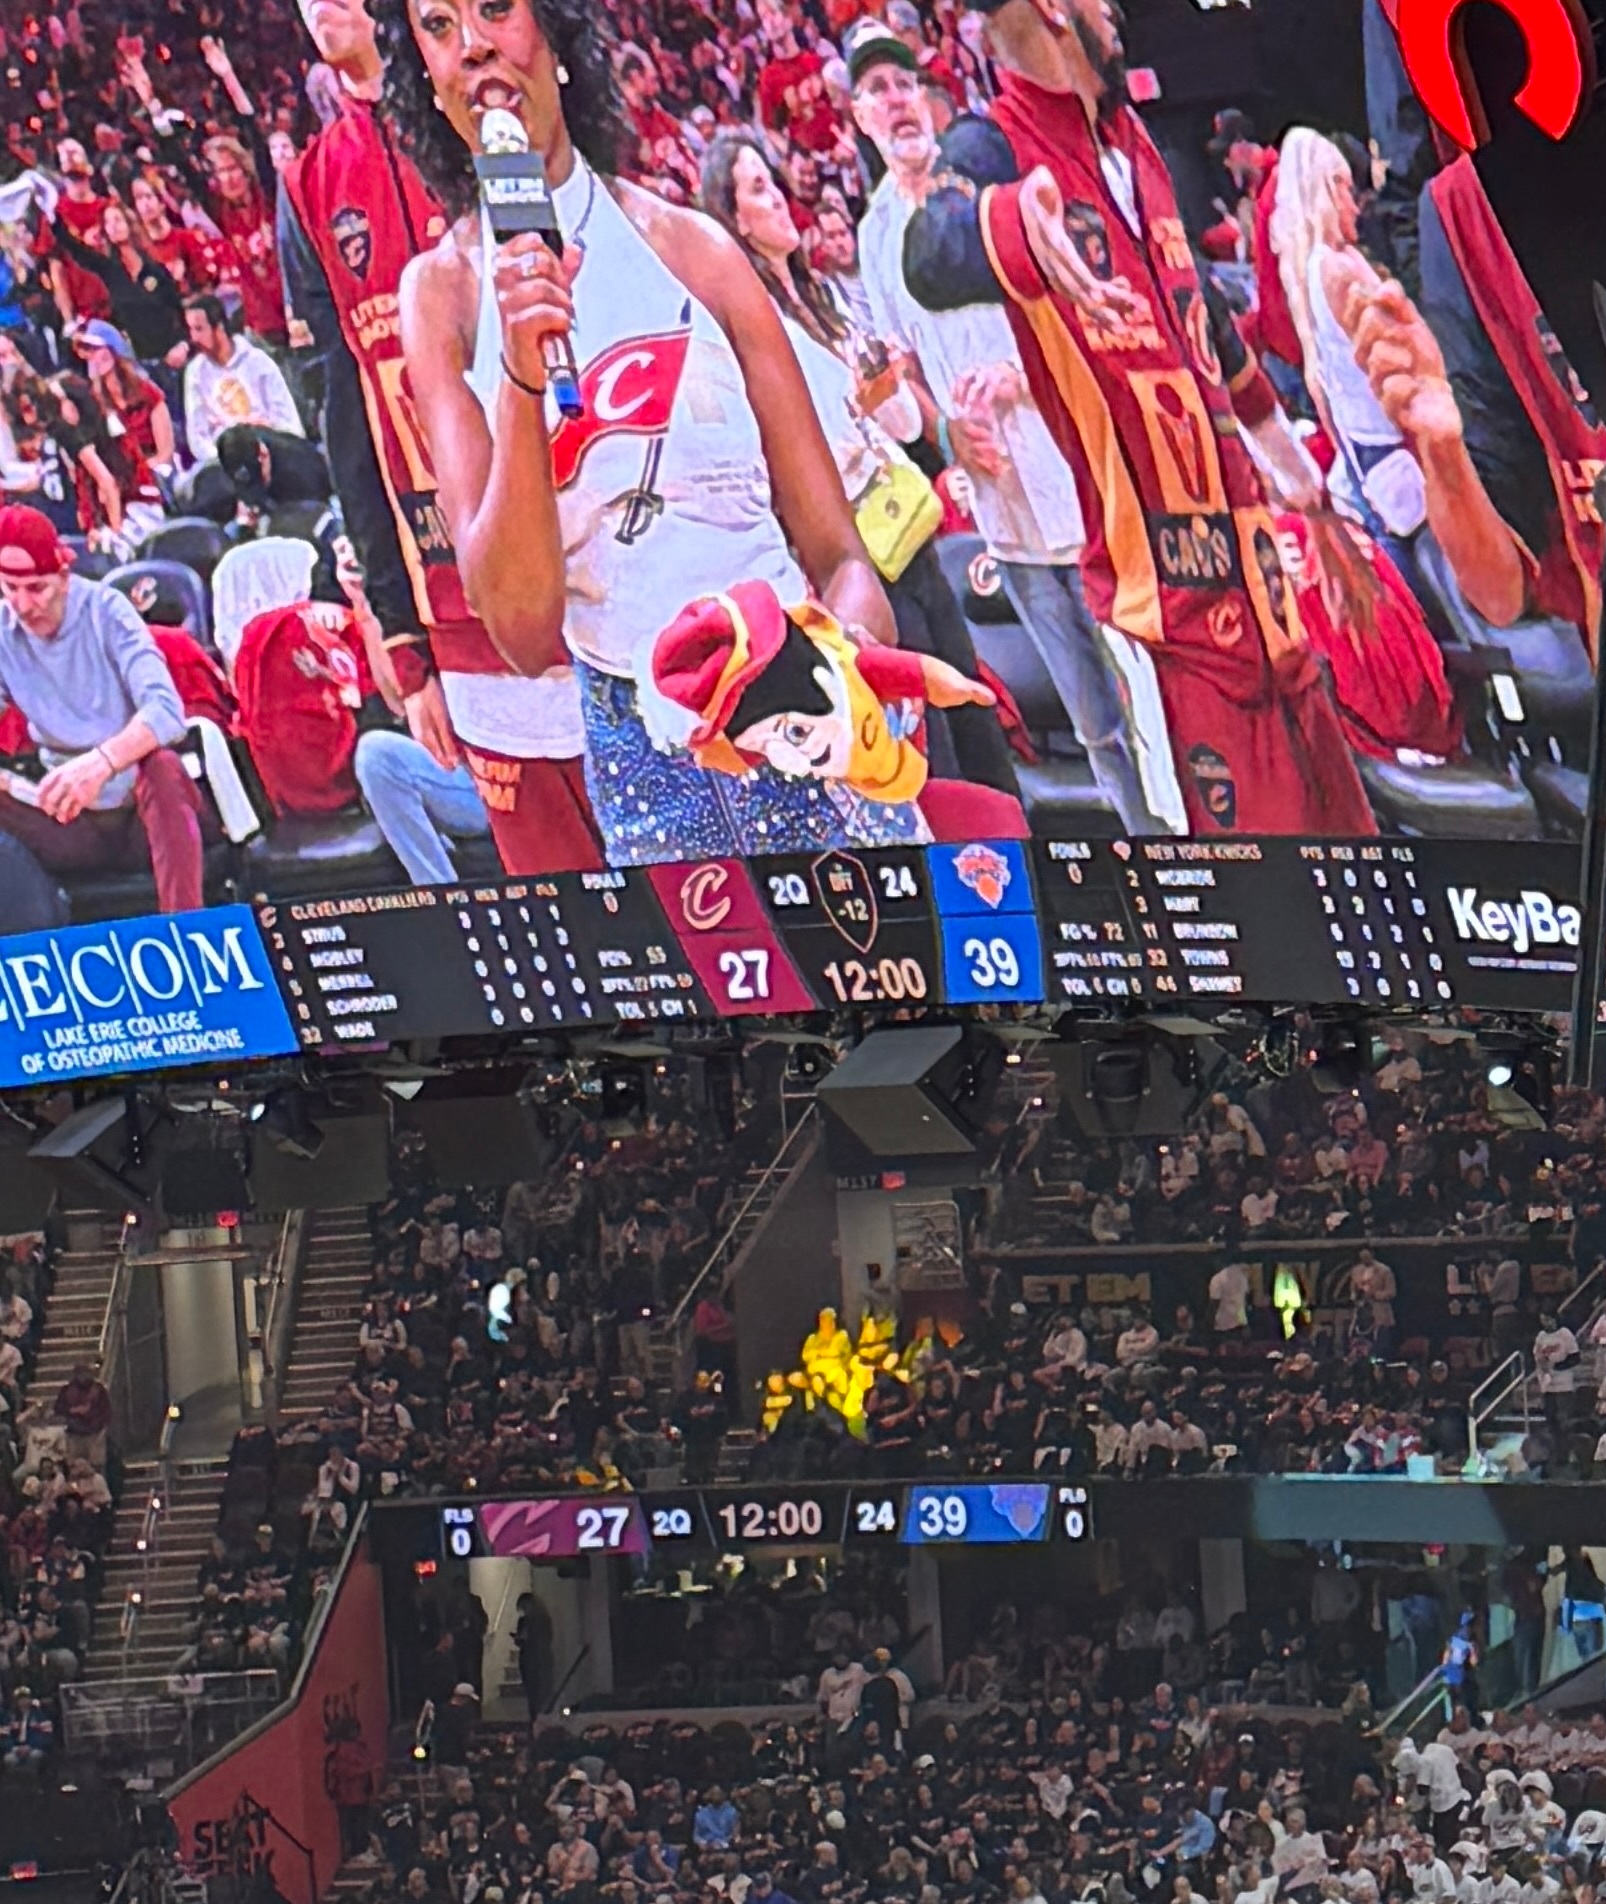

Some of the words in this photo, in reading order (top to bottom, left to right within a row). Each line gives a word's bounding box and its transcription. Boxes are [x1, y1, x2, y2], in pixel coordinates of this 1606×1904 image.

[768, 873, 811, 906] 2Q
[879, 866, 918, 898] 24
[838, 897, 870, 922] -12
[719, 948, 770, 1000] 27
[964, 937, 1020, 988] 39
[823, 957, 927, 1003] 12:00
[43, 1022, 89, 1049] LAKE
[89, 1018, 125, 1042] ERIE
[127, 1010, 202, 1036] COLLEGE
[21, 1053, 47, 1075] OF
[48, 1041, 163, 1071] OSTEOPATHIC
[164, 1028, 246, 1057] MEDICINE
[1058, 1486, 1088, 1504] FLS
[444, 1507, 475, 1524] FLS
[575, 1507, 630, 1549] 27
[651, 1507, 692, 1536] 2Q
[717, 1500, 823, 1537] 12:00
[856, 1500, 896, 1532] 24
[918, 1495, 968, 1536] 39
[1064, 1508, 1085, 1538] 0
[449, 1528, 471, 1557] 0
